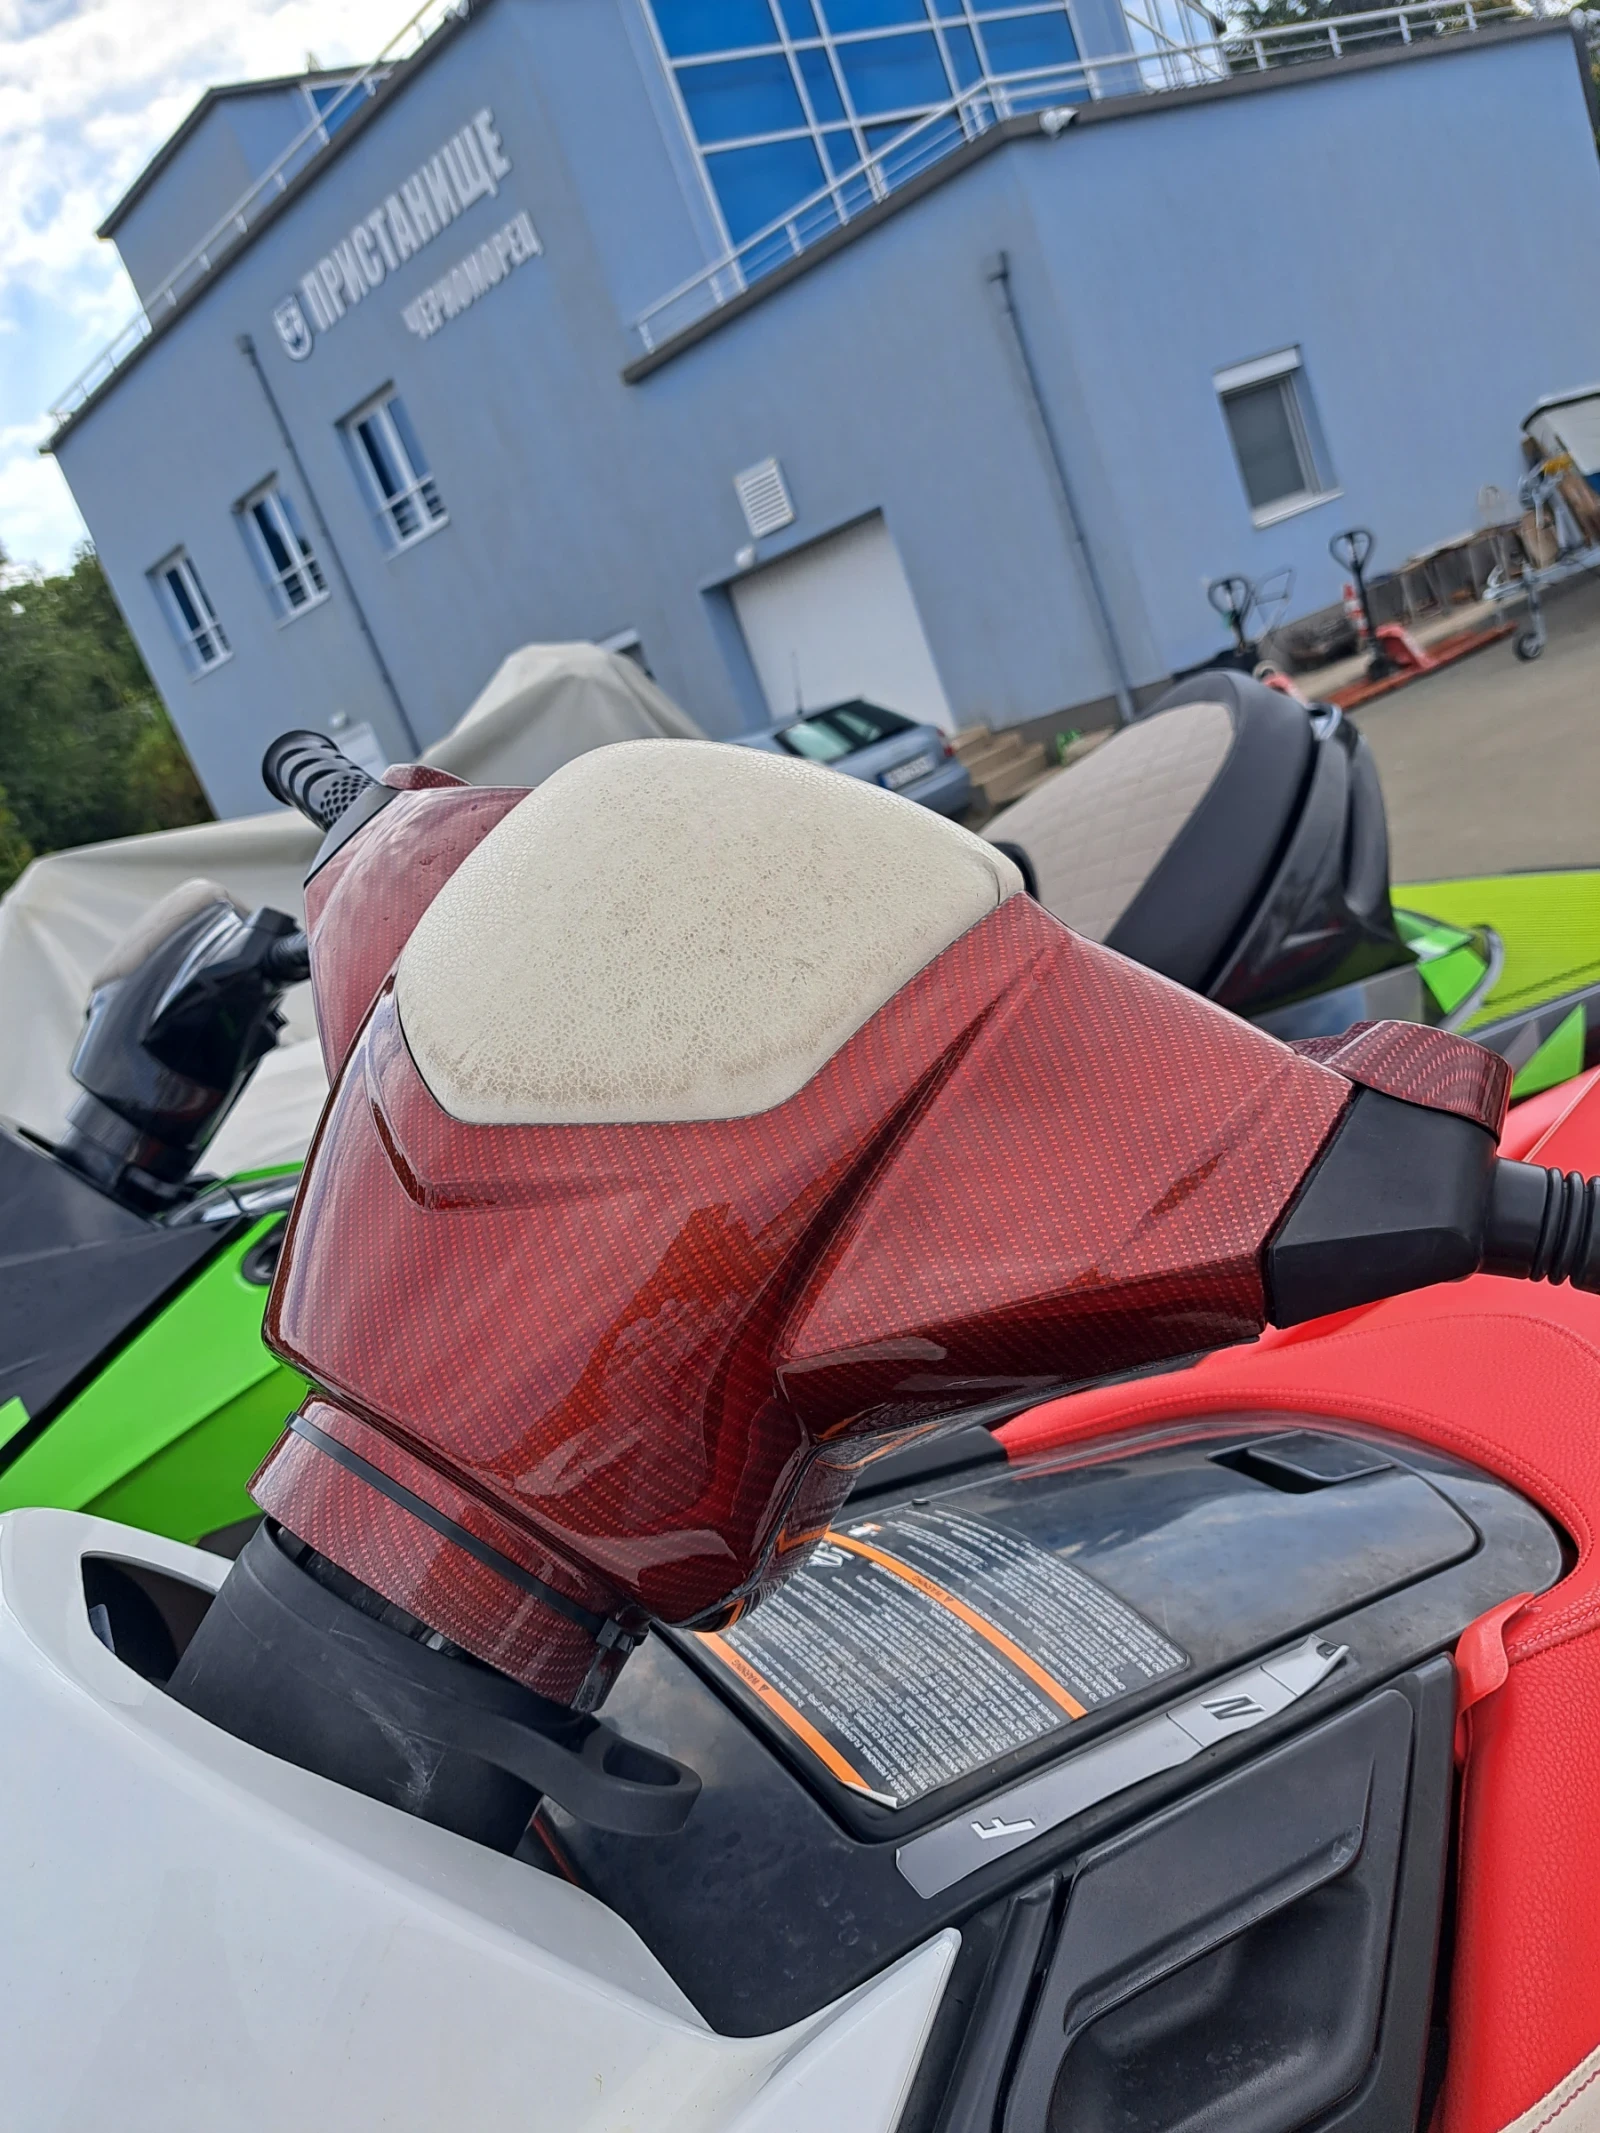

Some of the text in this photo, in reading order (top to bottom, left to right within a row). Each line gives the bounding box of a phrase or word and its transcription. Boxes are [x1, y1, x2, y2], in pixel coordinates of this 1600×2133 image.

[301, 106, 513, 334] ПРИСТАНИЩЕ
[401, 209, 544, 340] ЧЕРНОМОРЕЦ
[911, 1574, 943, 1598] WARNING
[731, 1658, 761, 1687] WARNING
[1202, 1692, 1266, 1720] N
[883, 1773, 894, 1781] A
[906, 1769, 930, 1791] WEAR
[889, 1779, 911, 1800] WEAR
[971, 1818, 1036, 1840] F
